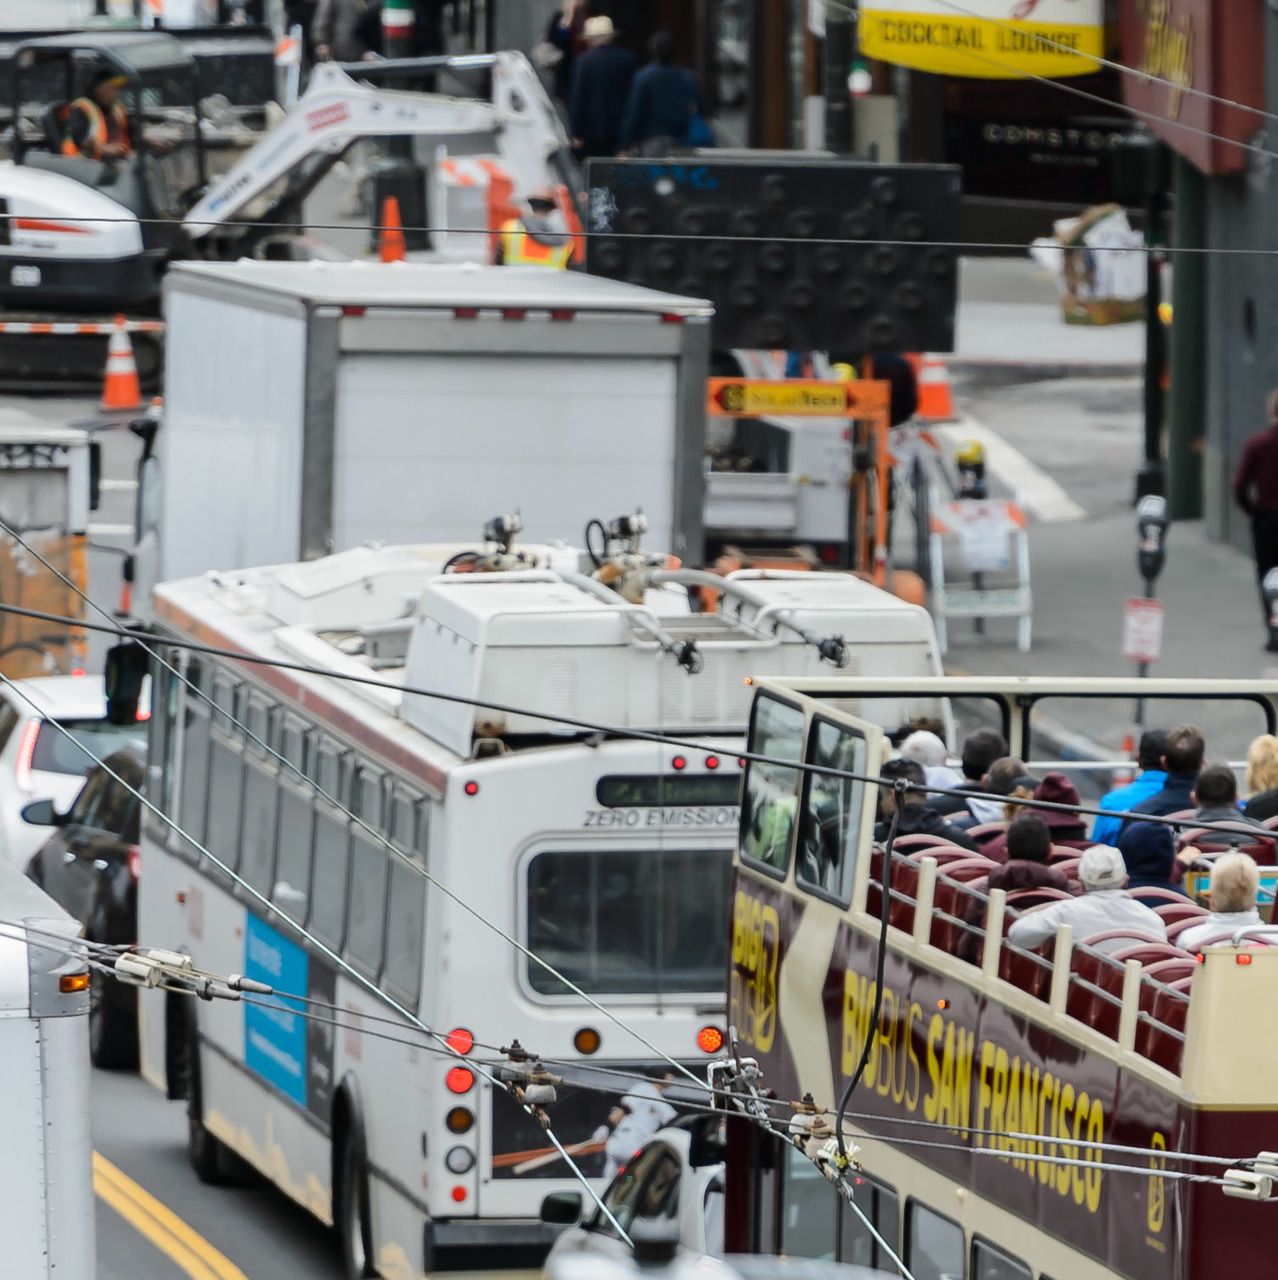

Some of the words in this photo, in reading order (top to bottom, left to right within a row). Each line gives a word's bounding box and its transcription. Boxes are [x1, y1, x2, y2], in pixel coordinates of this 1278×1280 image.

[882, 21, 984, 50] COCKTAIL
[994, 29, 1081, 56] LOUNGE
[584, 809, 639, 826] ZERO
[923, 1013, 975, 1140] SAN
[976, 1039, 1104, 1213] FRANCISCO
